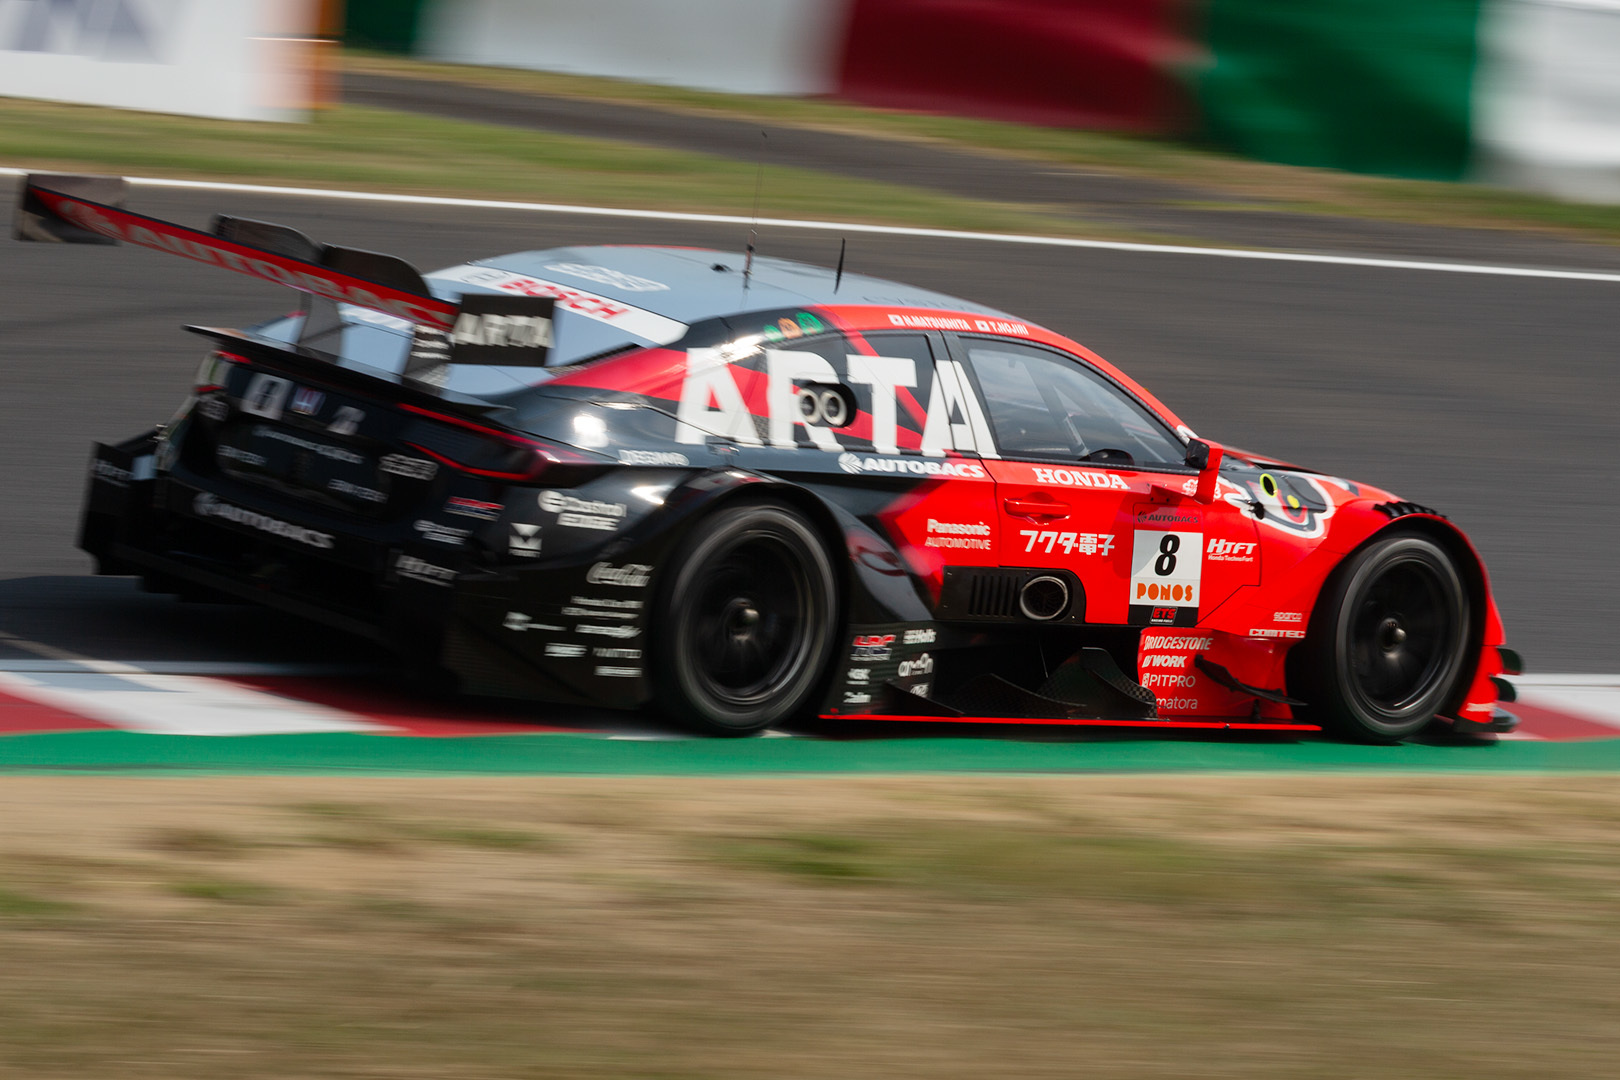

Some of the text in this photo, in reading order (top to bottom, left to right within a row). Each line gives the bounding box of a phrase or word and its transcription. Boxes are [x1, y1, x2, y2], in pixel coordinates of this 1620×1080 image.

[674, 347, 1002, 459] ARTA
[862, 457, 985, 478] AUTOBACS
[1032, 467, 1130, 489] HONDA
[927, 518, 991, 536] Panasonic
[1148, 514, 1199, 524] AUTOBACS
[925, 536, 992, 550] AUTOMOTIVE
[1020, 530, 1115, 556] フクダ電子
[1154, 534, 1180, 576] 8
[1137, 583, 1193, 602] PONOS
[1153, 607, 1176, 619] ETS
[1249, 628, 1306, 639] COMTEC
[1144, 636, 1213, 650] BRIDGESTONE
[1149, 674, 1196, 688] PITPRO
[1156, 696, 1198, 710] matora
